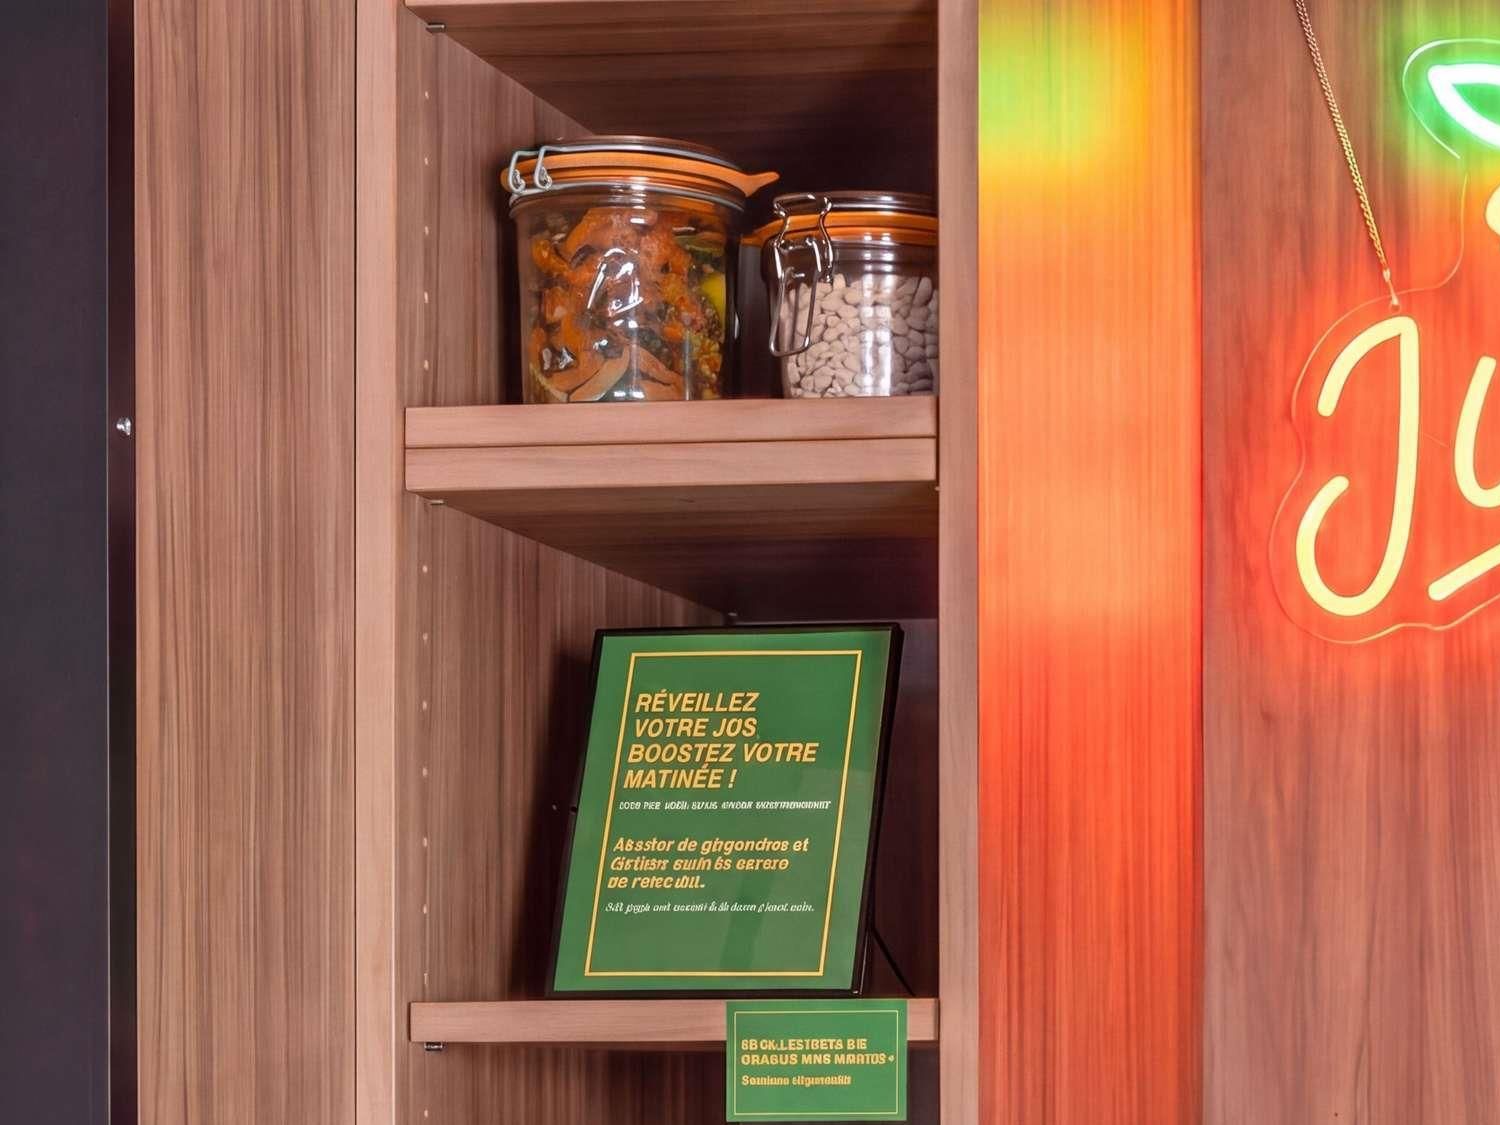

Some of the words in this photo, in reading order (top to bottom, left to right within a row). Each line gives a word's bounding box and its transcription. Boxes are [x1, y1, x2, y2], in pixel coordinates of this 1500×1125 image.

[635, 689, 760, 713] RÉVEILLEZ
[635, 718, 709, 738] VOTRE
[628, 743, 736, 763] BOOSTEZ
[743, 742, 819, 763] VOTRE
[623, 763, 724, 789] MATINÉE
